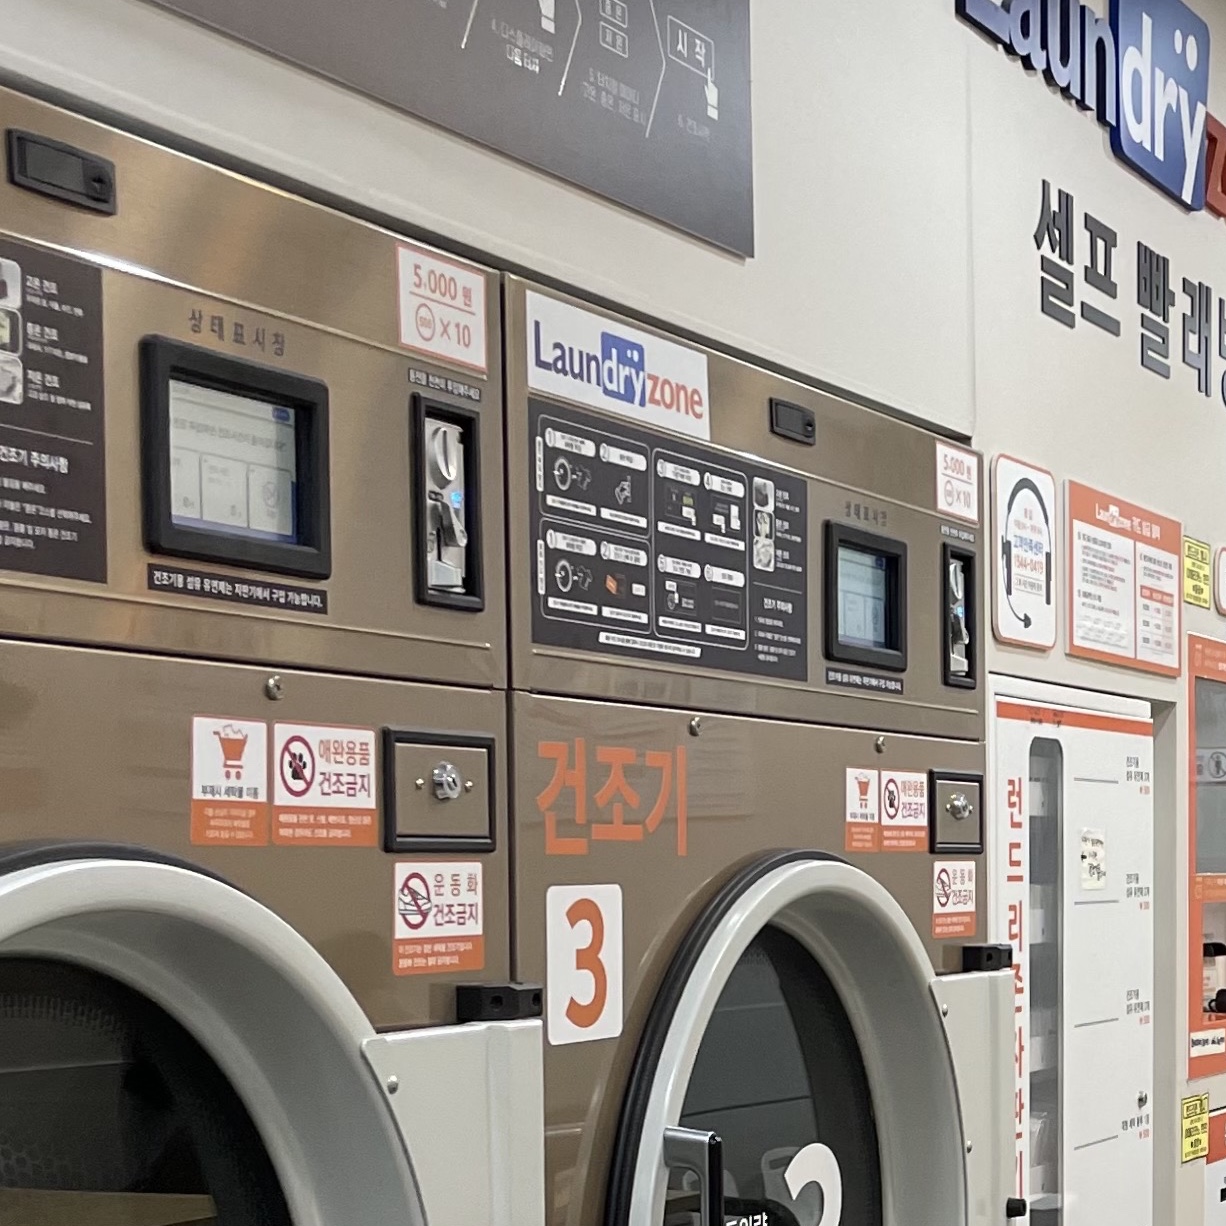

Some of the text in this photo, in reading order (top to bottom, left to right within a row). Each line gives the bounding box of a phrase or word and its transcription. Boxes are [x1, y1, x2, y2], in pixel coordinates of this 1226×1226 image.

[1034, 179, 1121, 337] 셀프
[189, 309, 285, 356] 상태표시창
[534, 320, 703, 419] Laundryzone
[318, 738, 371, 766] 애완용품
[318, 771, 371, 798] 건조금지
[536, 737, 689, 856] 건조기
[901, 802, 926, 819] 건조금지
[434, 873, 478, 897] 운동화
[433, 902, 479, 927] 건조금지
[565, 898, 608, 1028] 3
